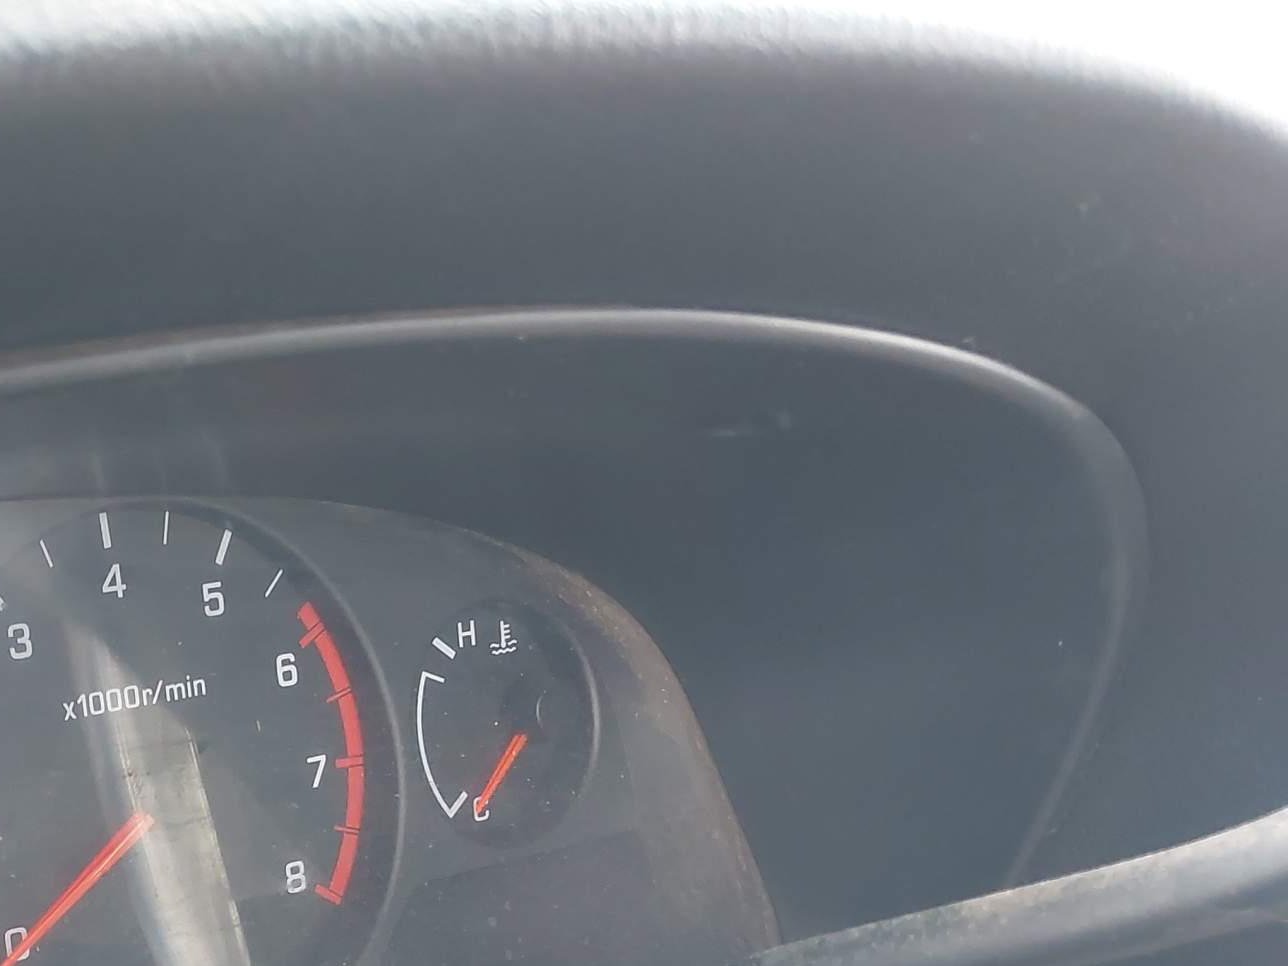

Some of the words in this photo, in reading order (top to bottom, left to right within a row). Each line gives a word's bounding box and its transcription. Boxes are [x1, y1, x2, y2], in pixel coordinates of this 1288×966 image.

[102, 564, 127, 598] 4
[201, 581, 224, 617] 5
[7, 623, 32, 660] 3
[458, 620, 476, 648] H
[275, 652, 298, 688] 6
[63, 674, 207, 721] x1000r/min
[306, 754, 327, 789] 7
[285, 860, 307, 894] 8
[4, 927, 31, 961] 0
